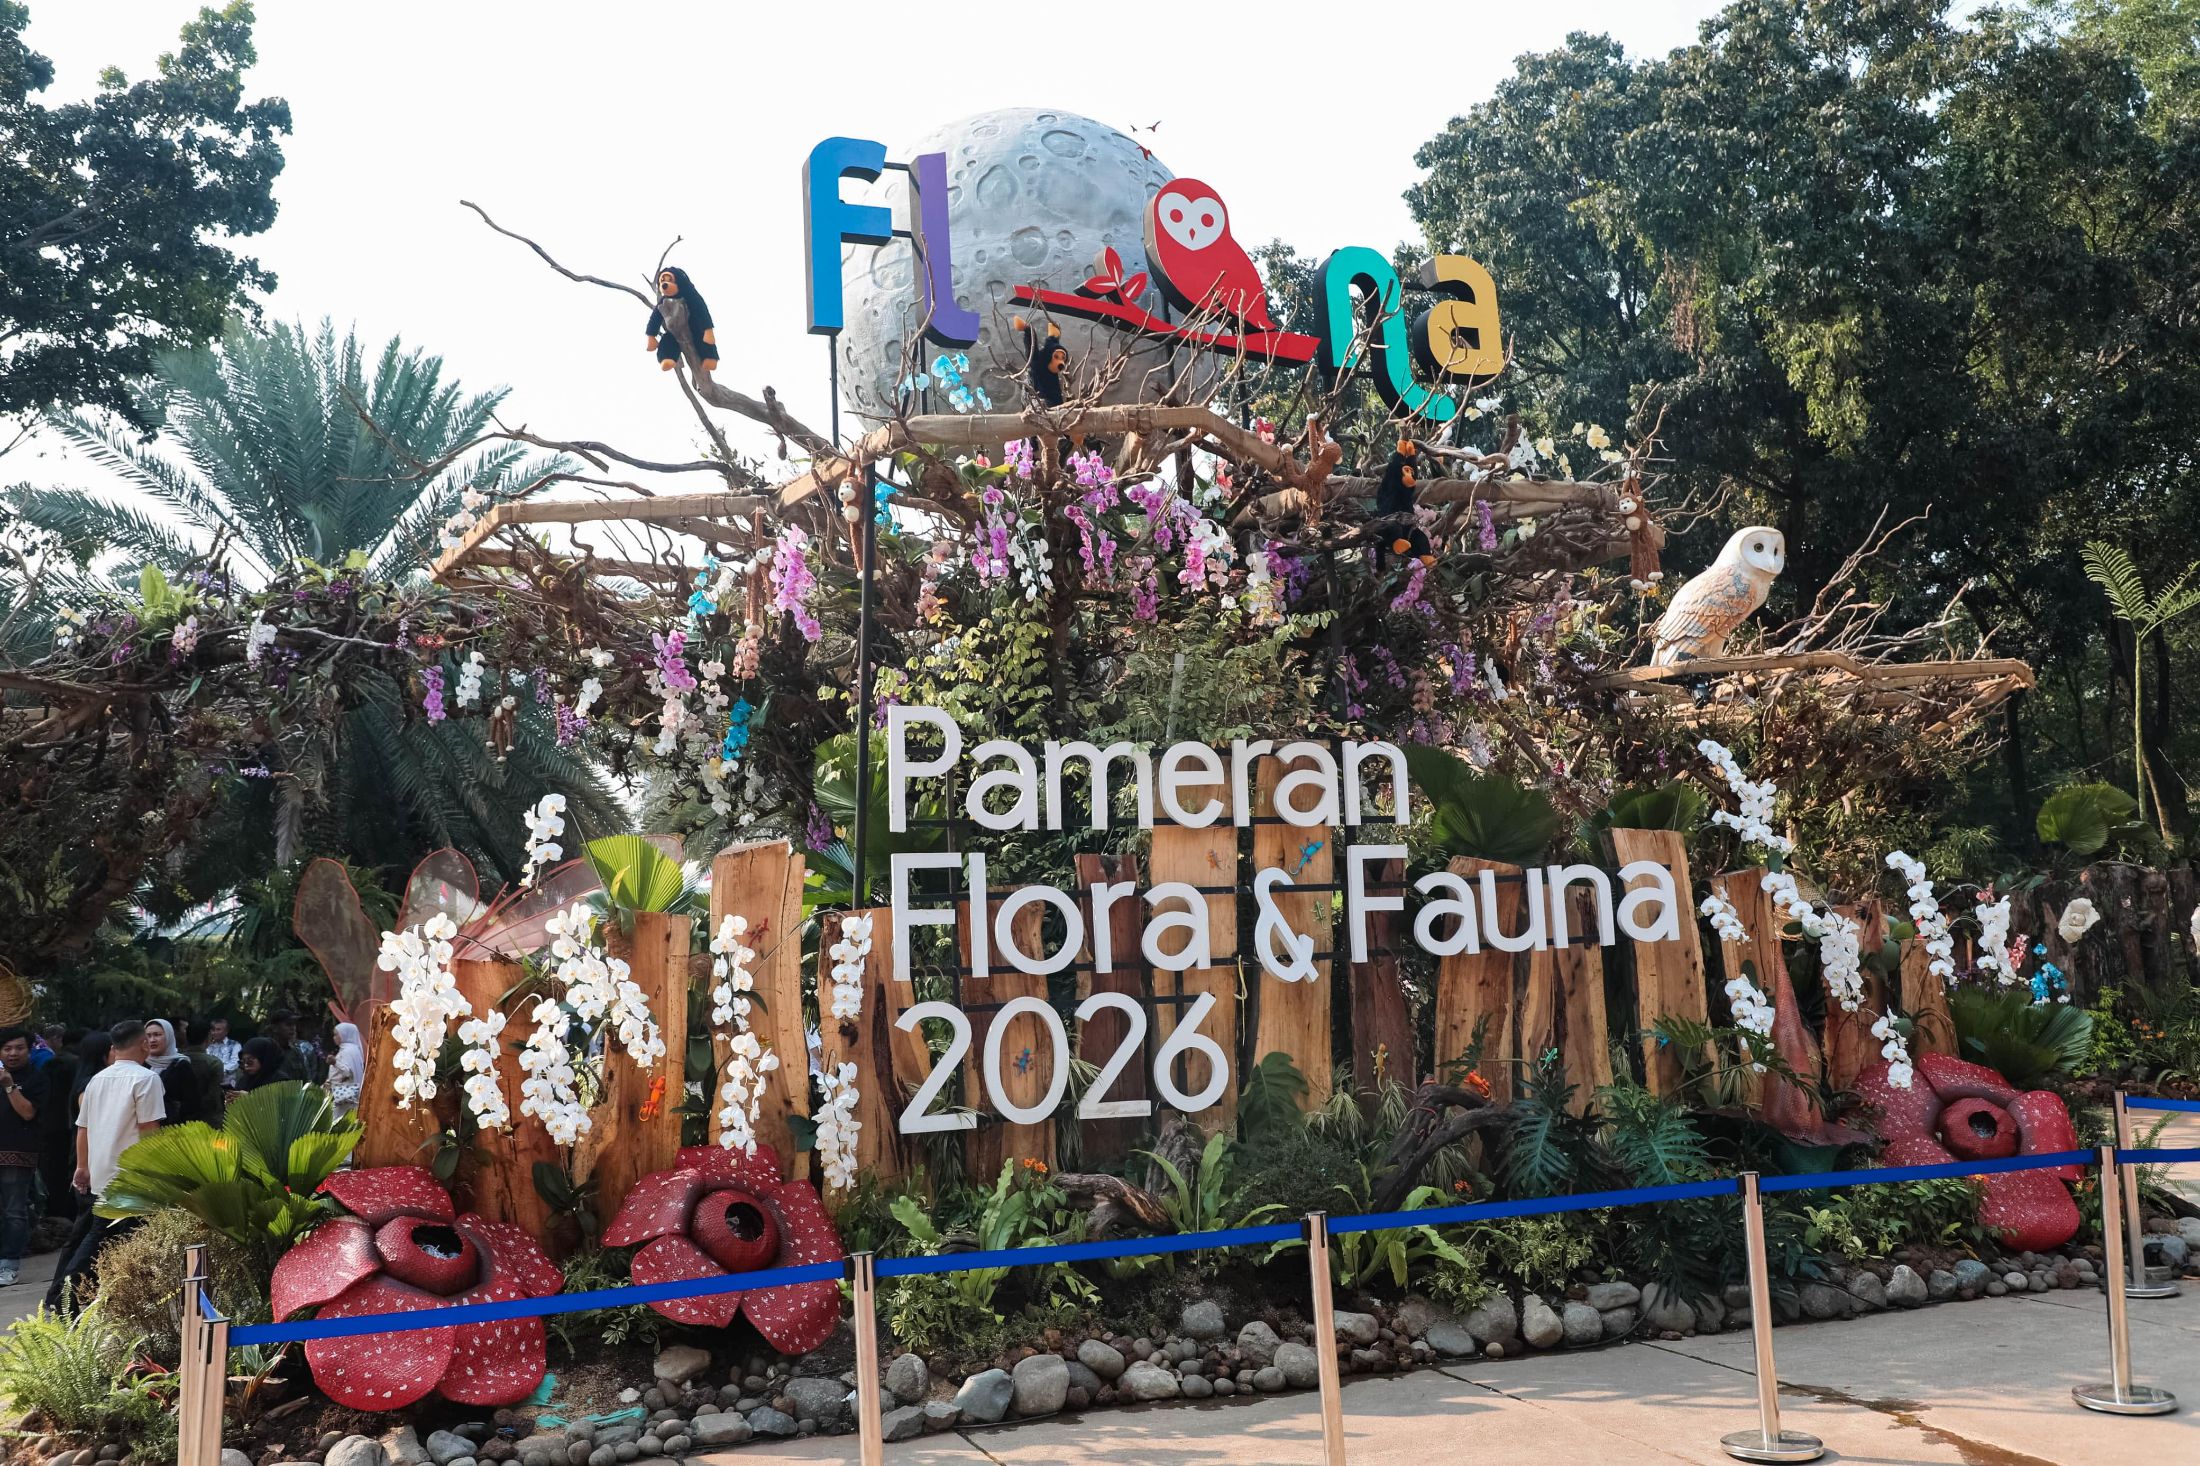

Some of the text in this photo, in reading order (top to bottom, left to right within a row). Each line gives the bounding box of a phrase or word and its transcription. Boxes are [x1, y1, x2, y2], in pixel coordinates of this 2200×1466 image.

[888, 704, 1411, 832] Pameran
[891, 844, 1681, 984] Flora & Fauna
[895, 991, 1229, 1134] 2026
